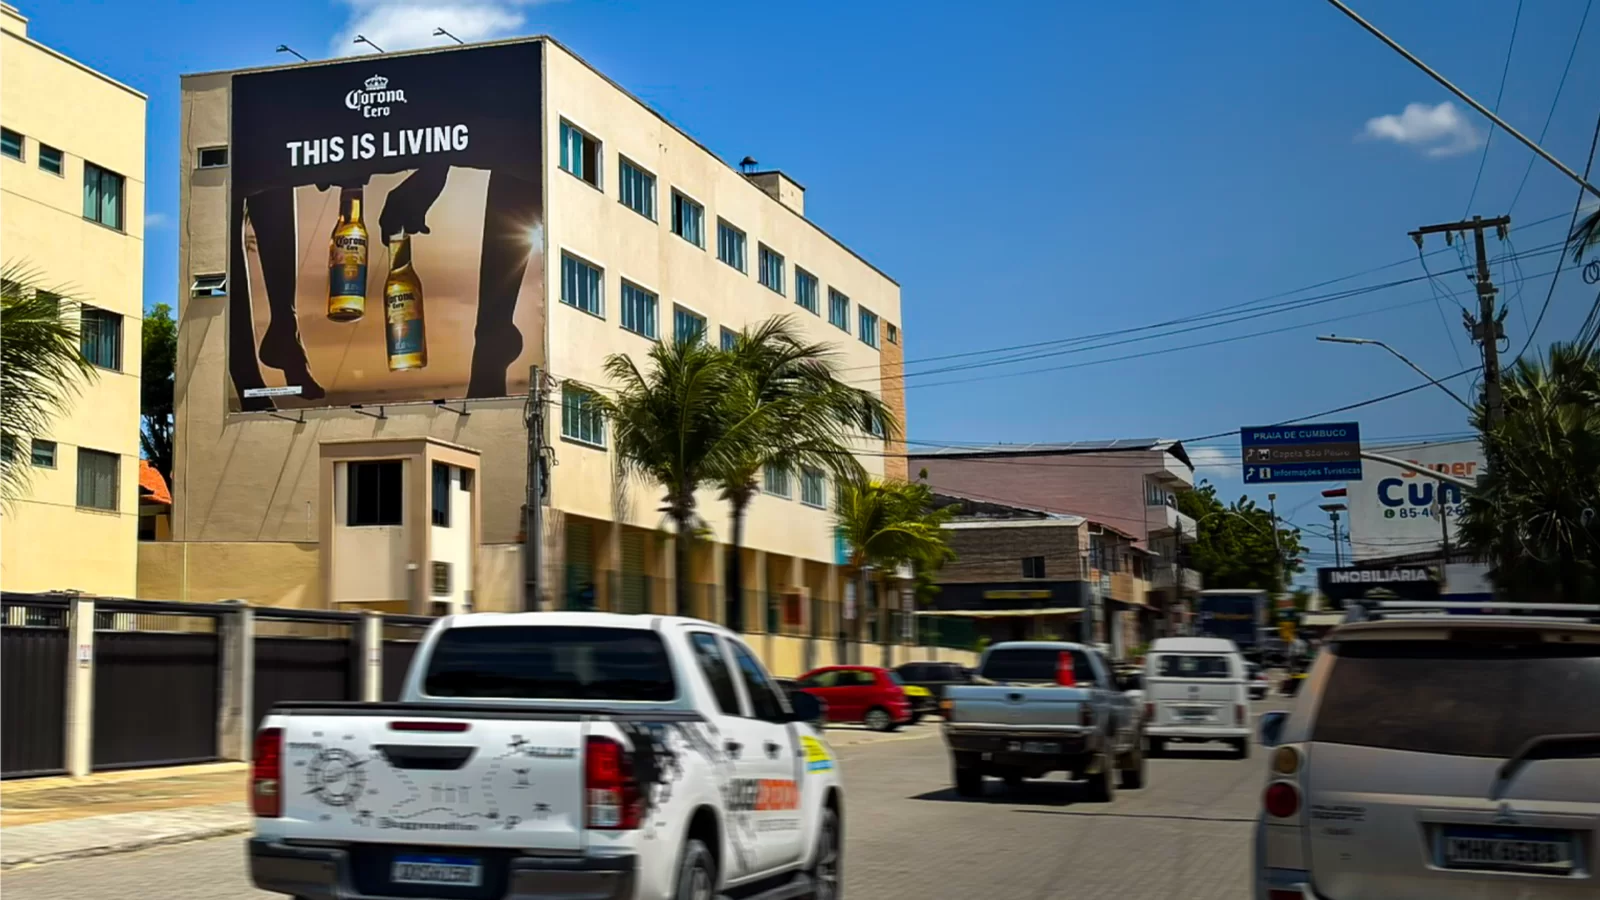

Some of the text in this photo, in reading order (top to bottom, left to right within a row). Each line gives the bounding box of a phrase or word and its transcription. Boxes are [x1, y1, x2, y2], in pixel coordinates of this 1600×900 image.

[345, 88, 408, 111] Corona
[363, 105, 390, 118] Cero
[286, 124, 469, 167] THIS IS LIVING
[1253, 429, 1347, 440] PRAIA DE CUMBUCO
[1273, 468, 1322, 477] Informações
[1331, 566, 1429, 583] IMOBILIÁRIA
